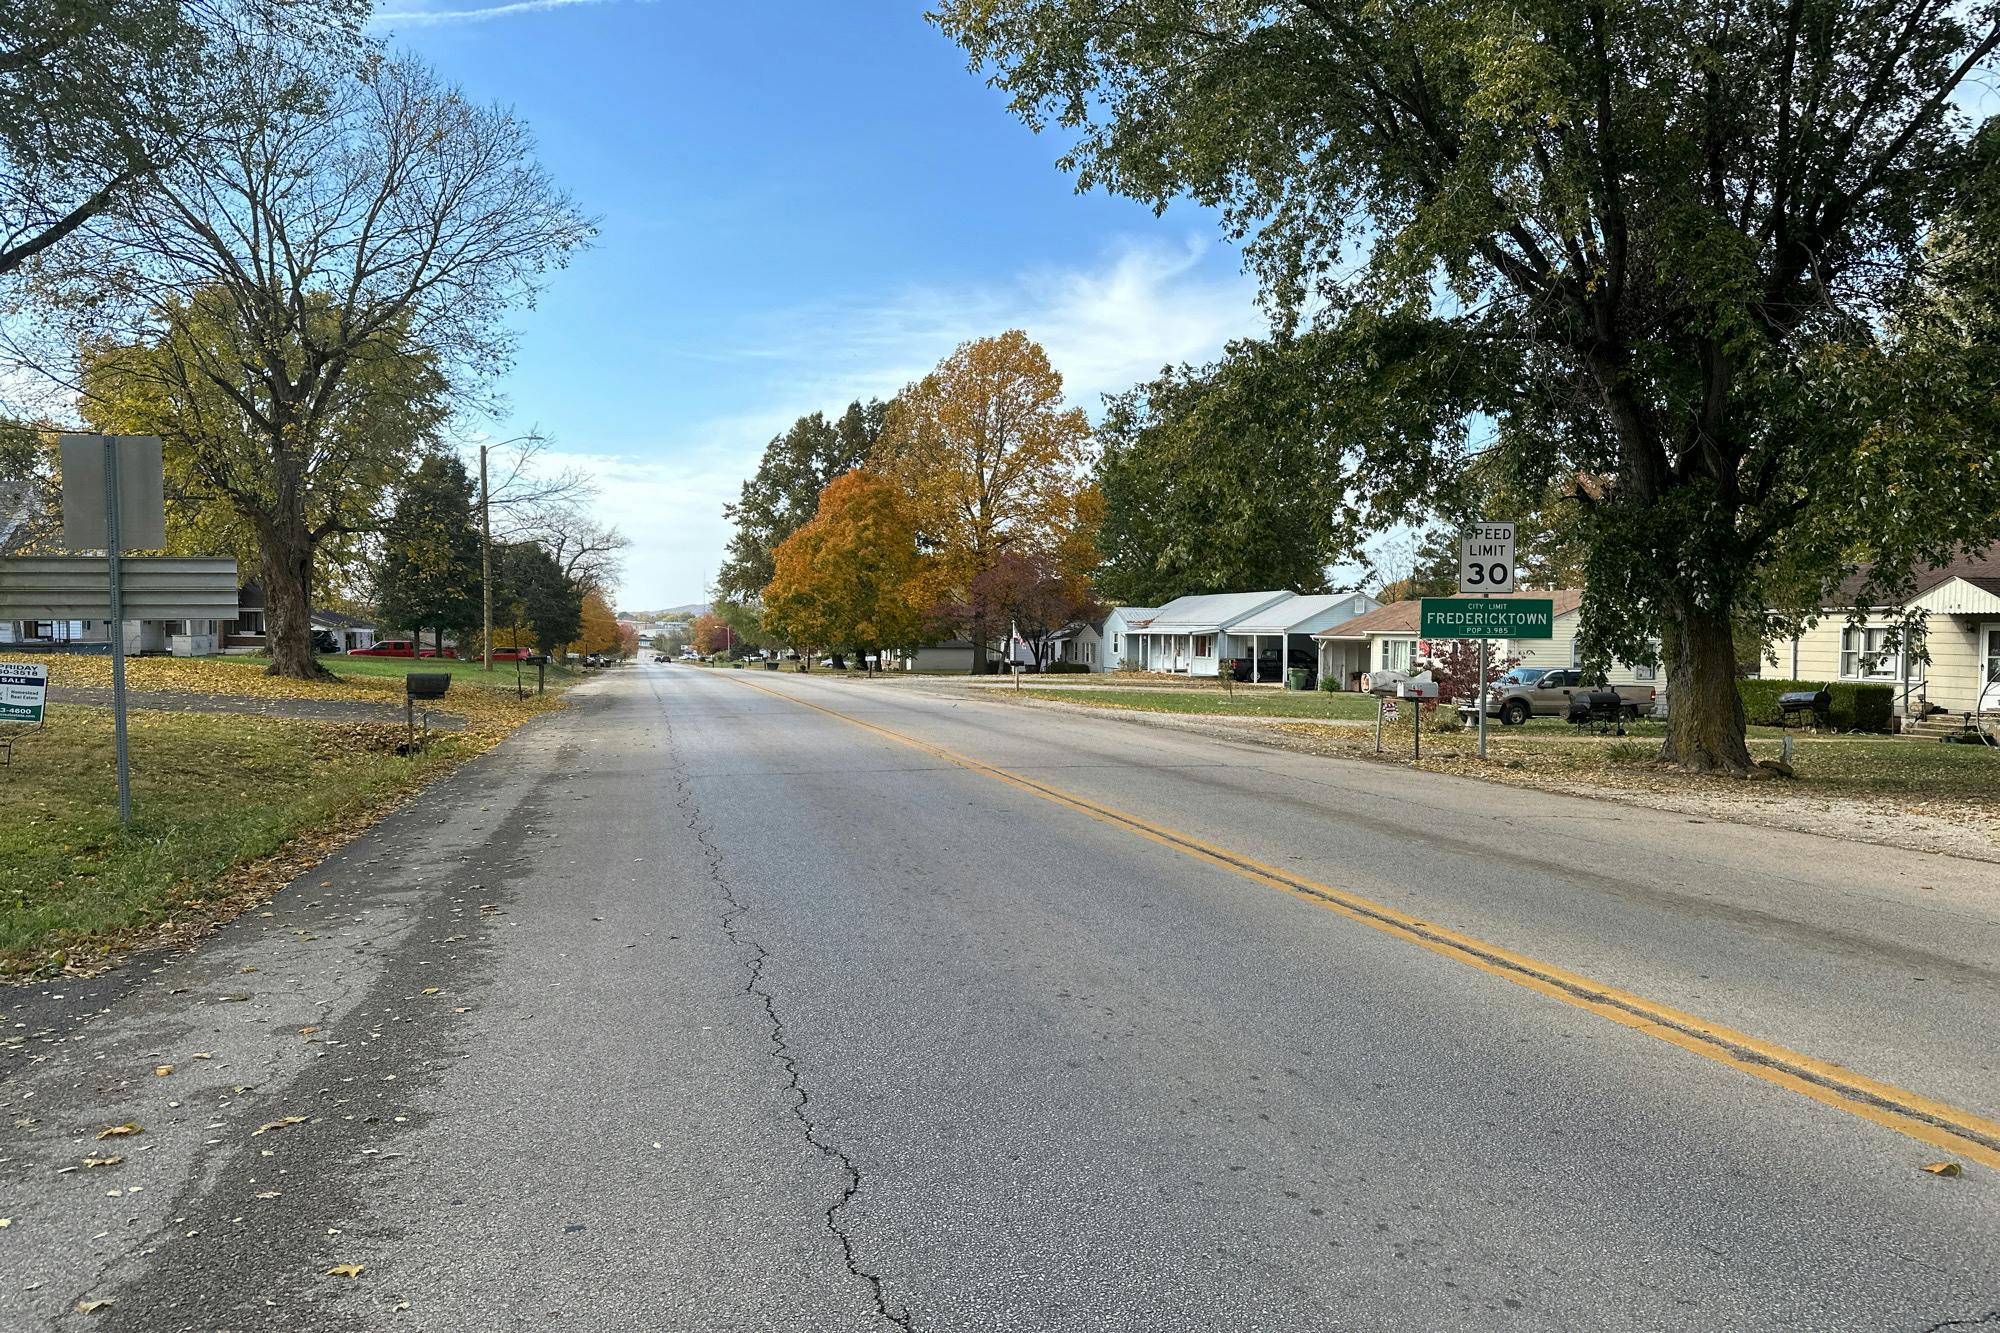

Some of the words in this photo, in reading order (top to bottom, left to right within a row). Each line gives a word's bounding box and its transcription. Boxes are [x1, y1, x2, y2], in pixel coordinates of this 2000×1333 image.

[1469, 544, 1506, 556] LIMIT
[1466, 562, 1508, 585] 30
[1427, 612, 1547, 625] FREDERICKTOWN
